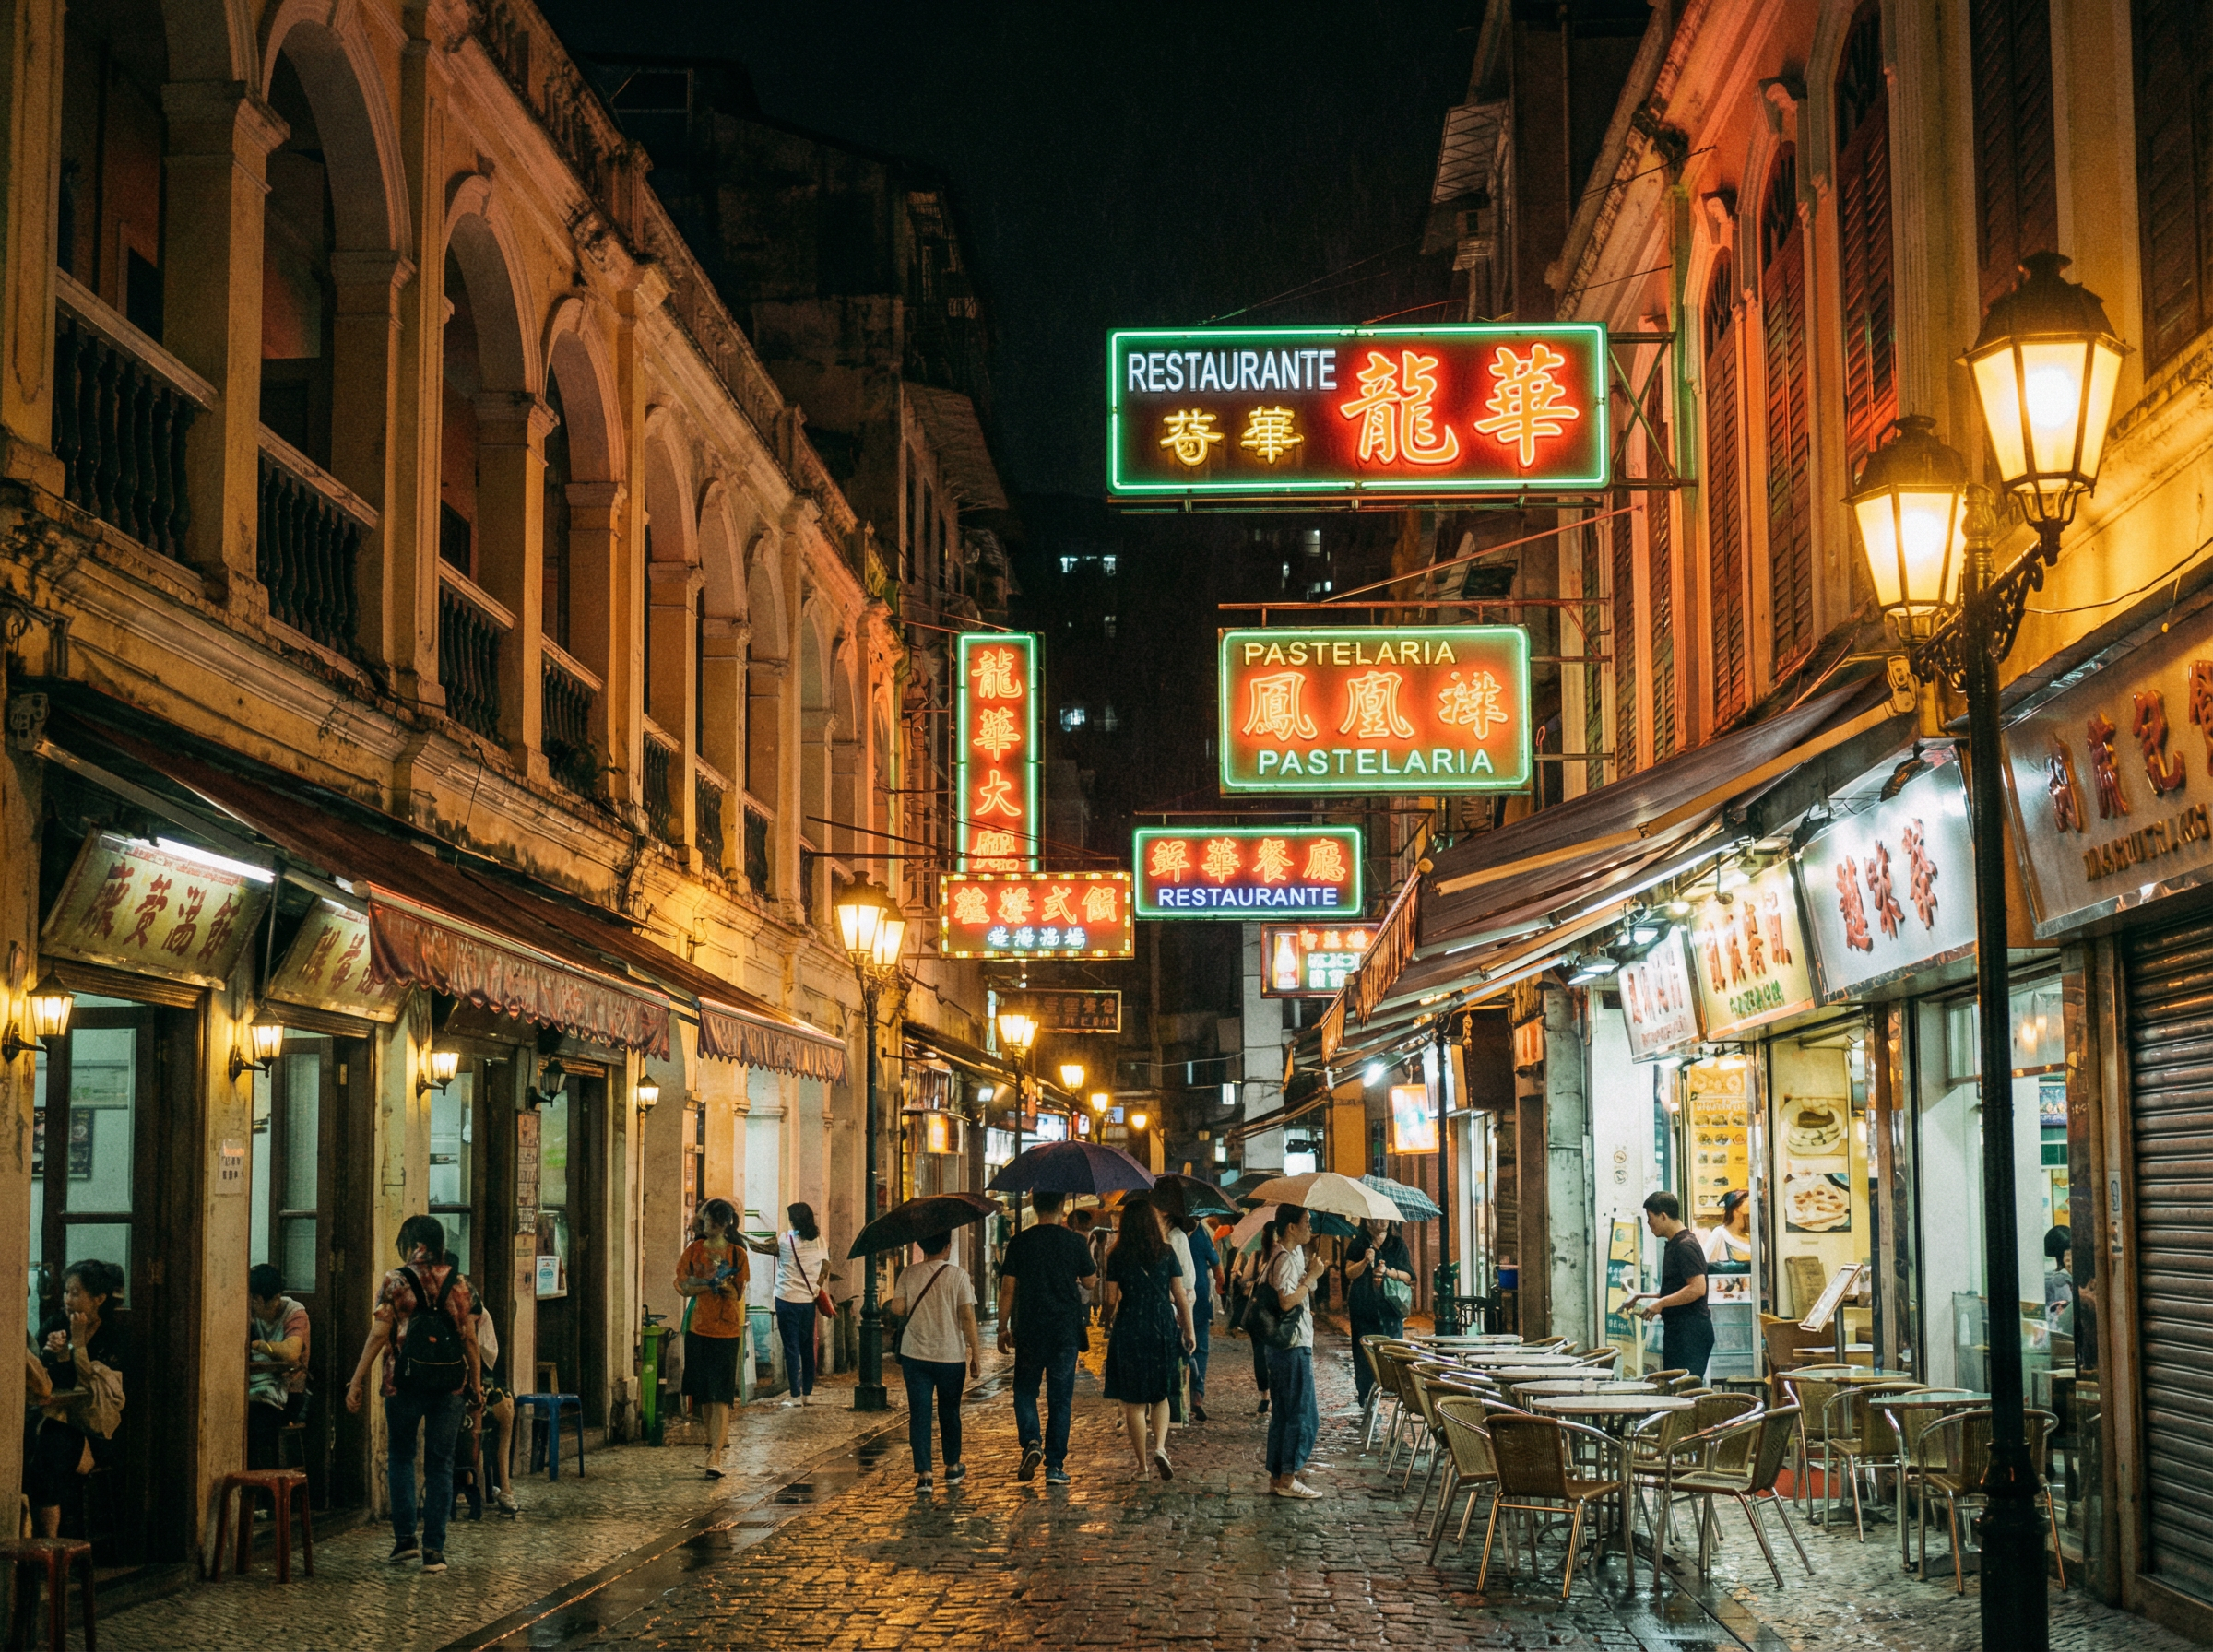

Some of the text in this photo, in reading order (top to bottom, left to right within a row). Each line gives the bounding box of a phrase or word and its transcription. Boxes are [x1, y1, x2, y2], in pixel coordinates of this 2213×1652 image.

[1128, 348, 1338, 393] RESTAURANTE
[1340, 341, 1580, 468] 龍華
[1244, 640, 1458, 667] PASTELARIA
[1257, 748, 1495, 776] PASTELARIA
[1158, 887, 1338, 907] RESTAURANTE
